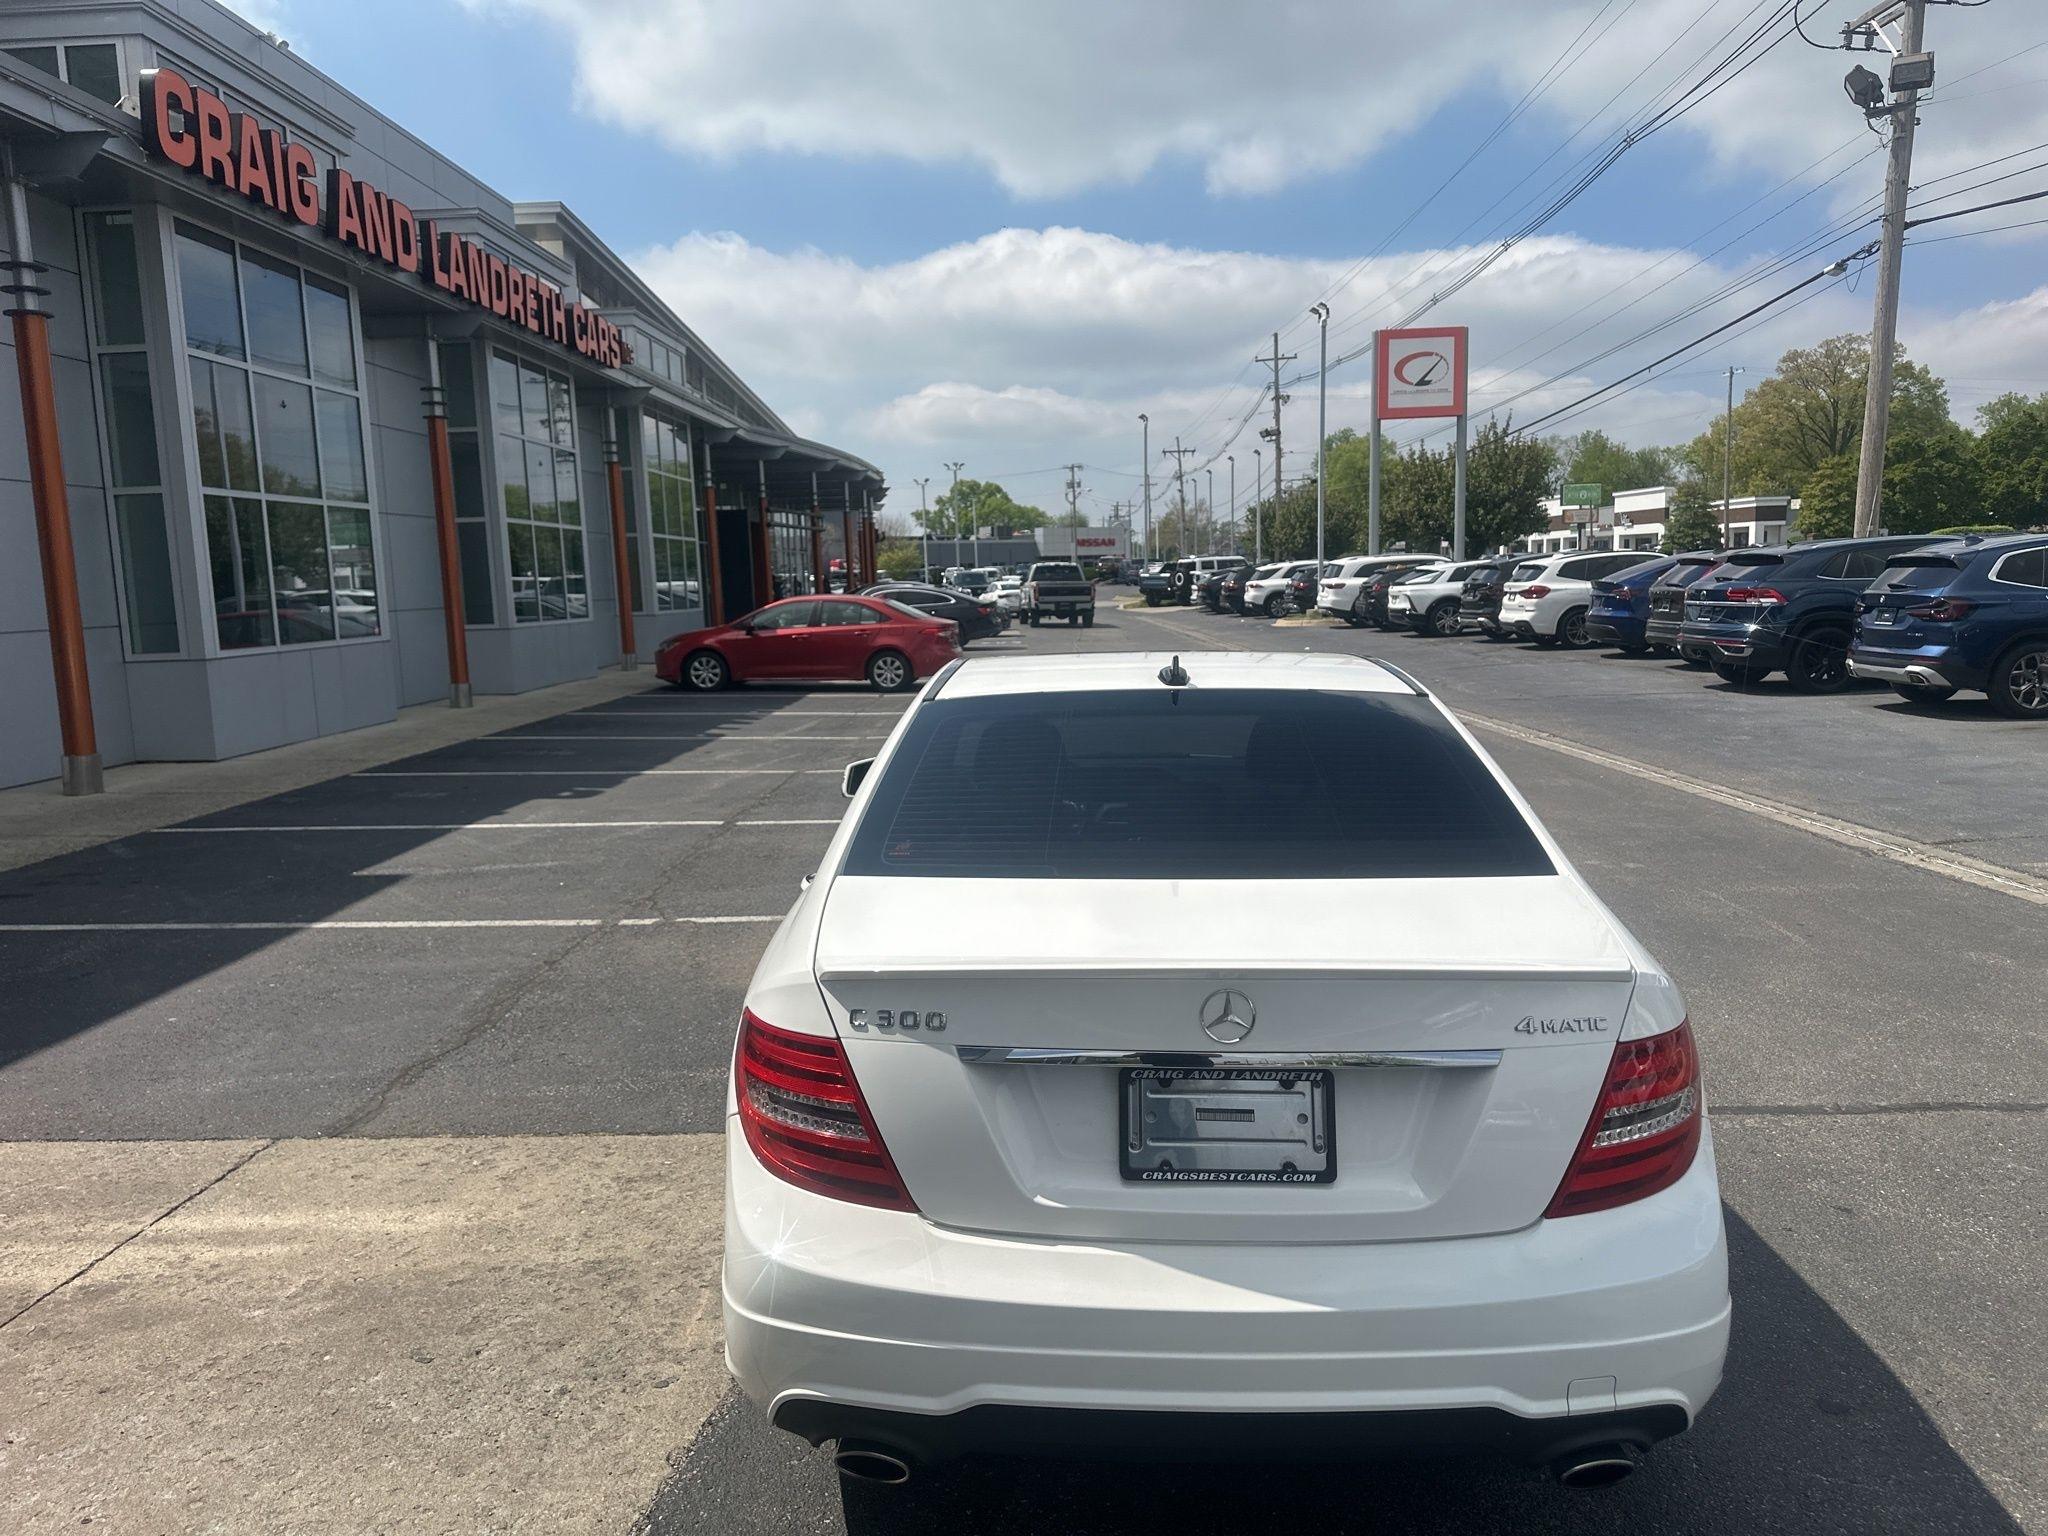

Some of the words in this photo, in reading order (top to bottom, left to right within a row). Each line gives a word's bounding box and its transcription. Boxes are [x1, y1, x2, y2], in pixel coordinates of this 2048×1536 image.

[153, 67, 320, 226] CRAIG
[337, 168, 418, 273] AND
[428, 219, 568, 345] LANDRETH
[573, 302, 621, 369] CARS
[849, 1008, 867, 1028] C
[876, 1009, 948, 1032] 300
[1130, 1069, 1185, 1080] CRAIG
[1188, 1070, 1226, 1080] AND
[1229, 1070, 1325, 1082] LANDRETH
[1142, 1170, 1317, 1183] CRAIGSBESTCARS.COM
